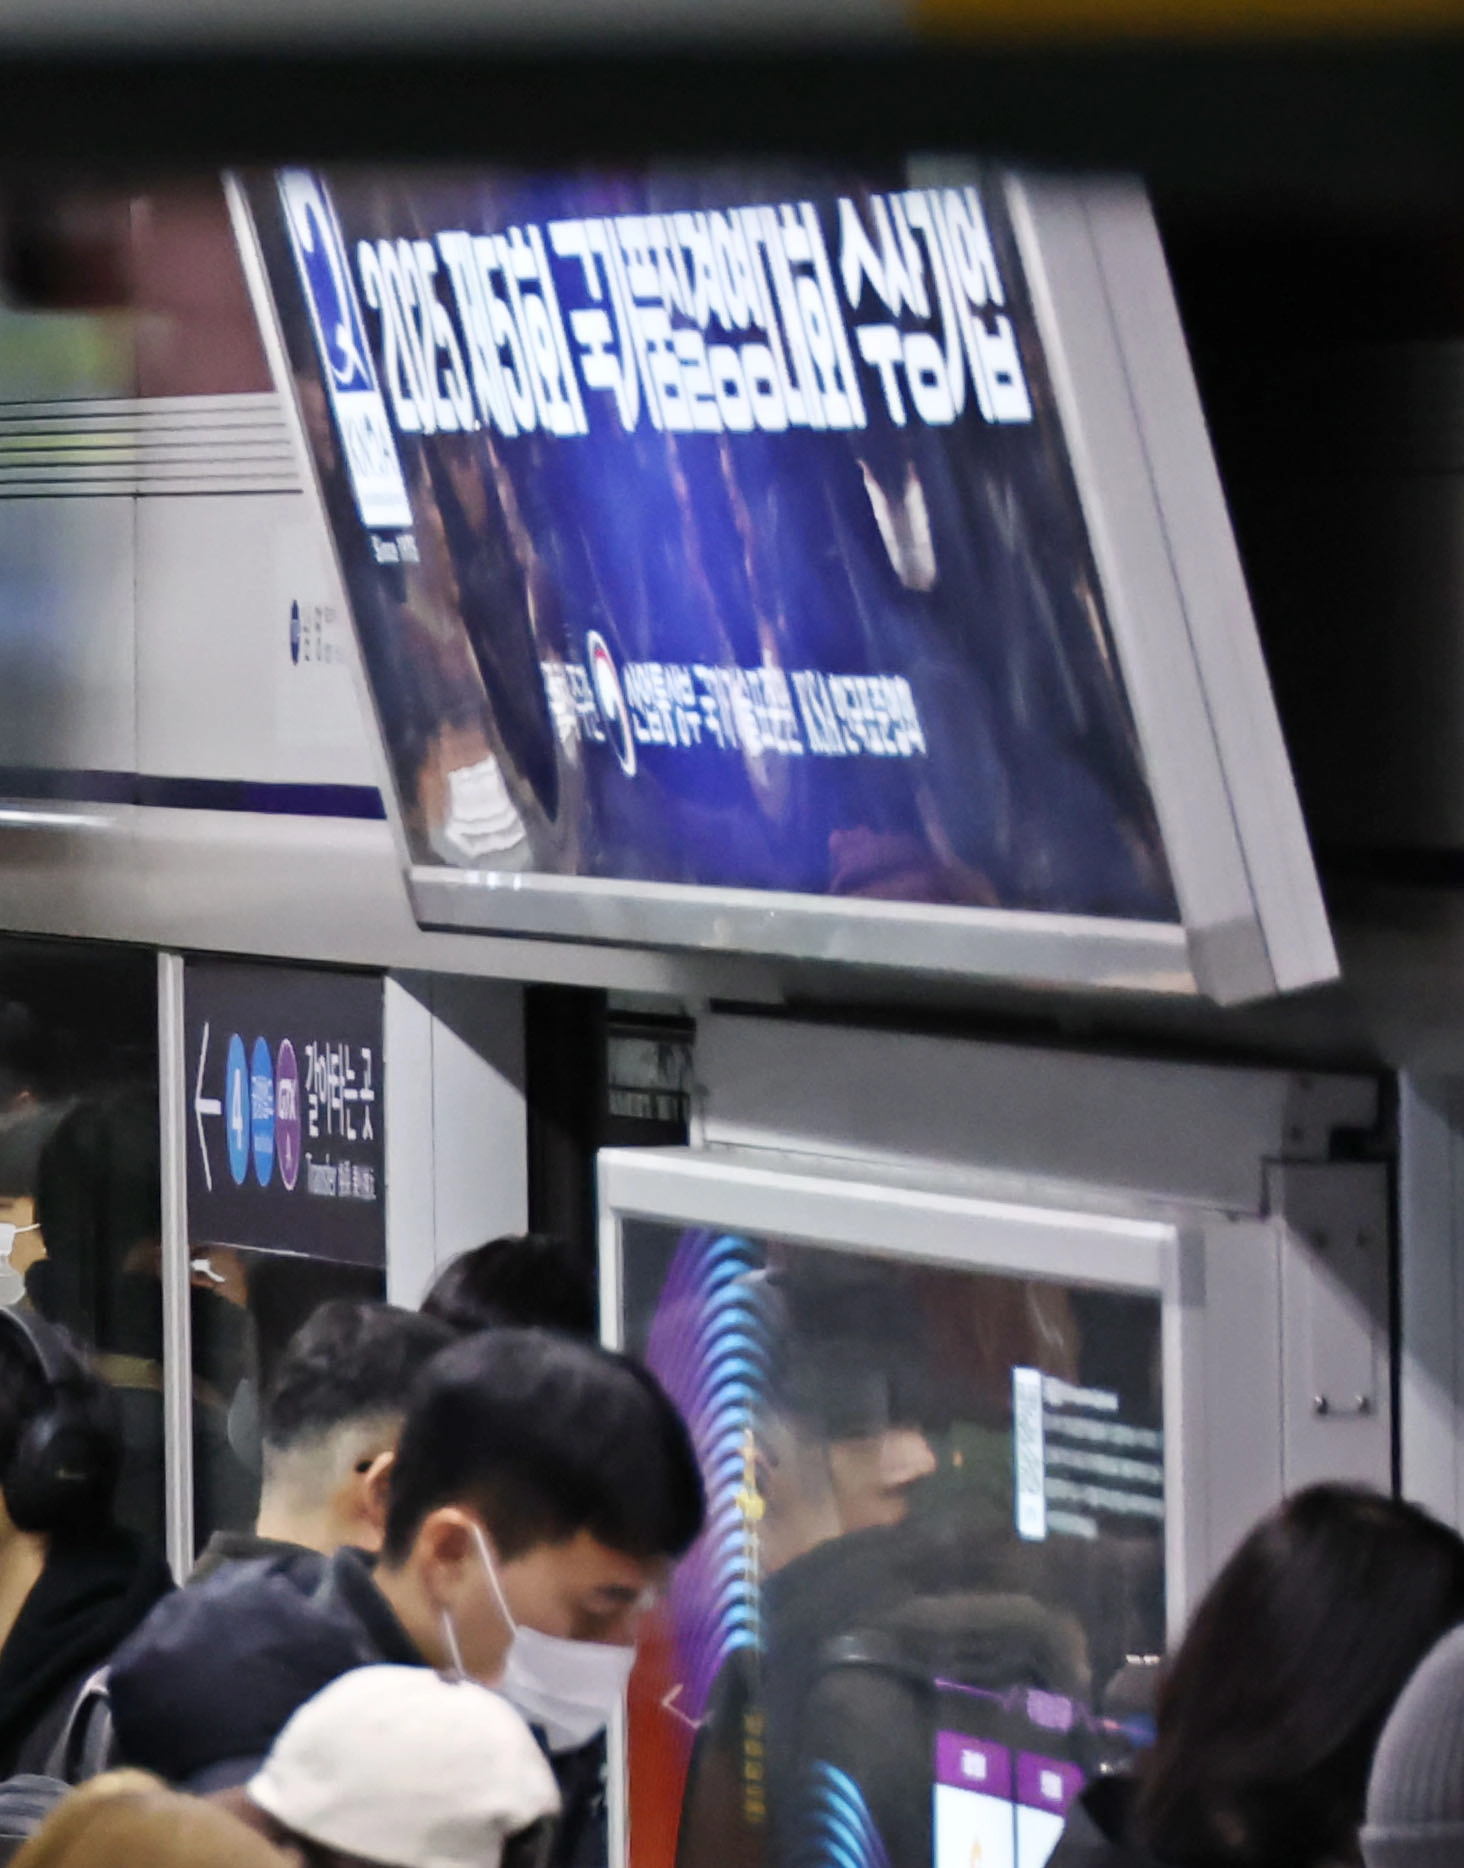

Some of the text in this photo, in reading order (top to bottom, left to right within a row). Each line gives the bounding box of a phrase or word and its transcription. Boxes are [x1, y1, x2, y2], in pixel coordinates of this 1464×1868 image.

[357, 238, 474, 434] 2025
[547, 201, 867, 433] 국가품질경영대회
[838, 186, 1032, 428] 수상기업
[232, 1068, 244, 1150] 4
[305, 1040, 375, 1141] 갈아타는 곳
